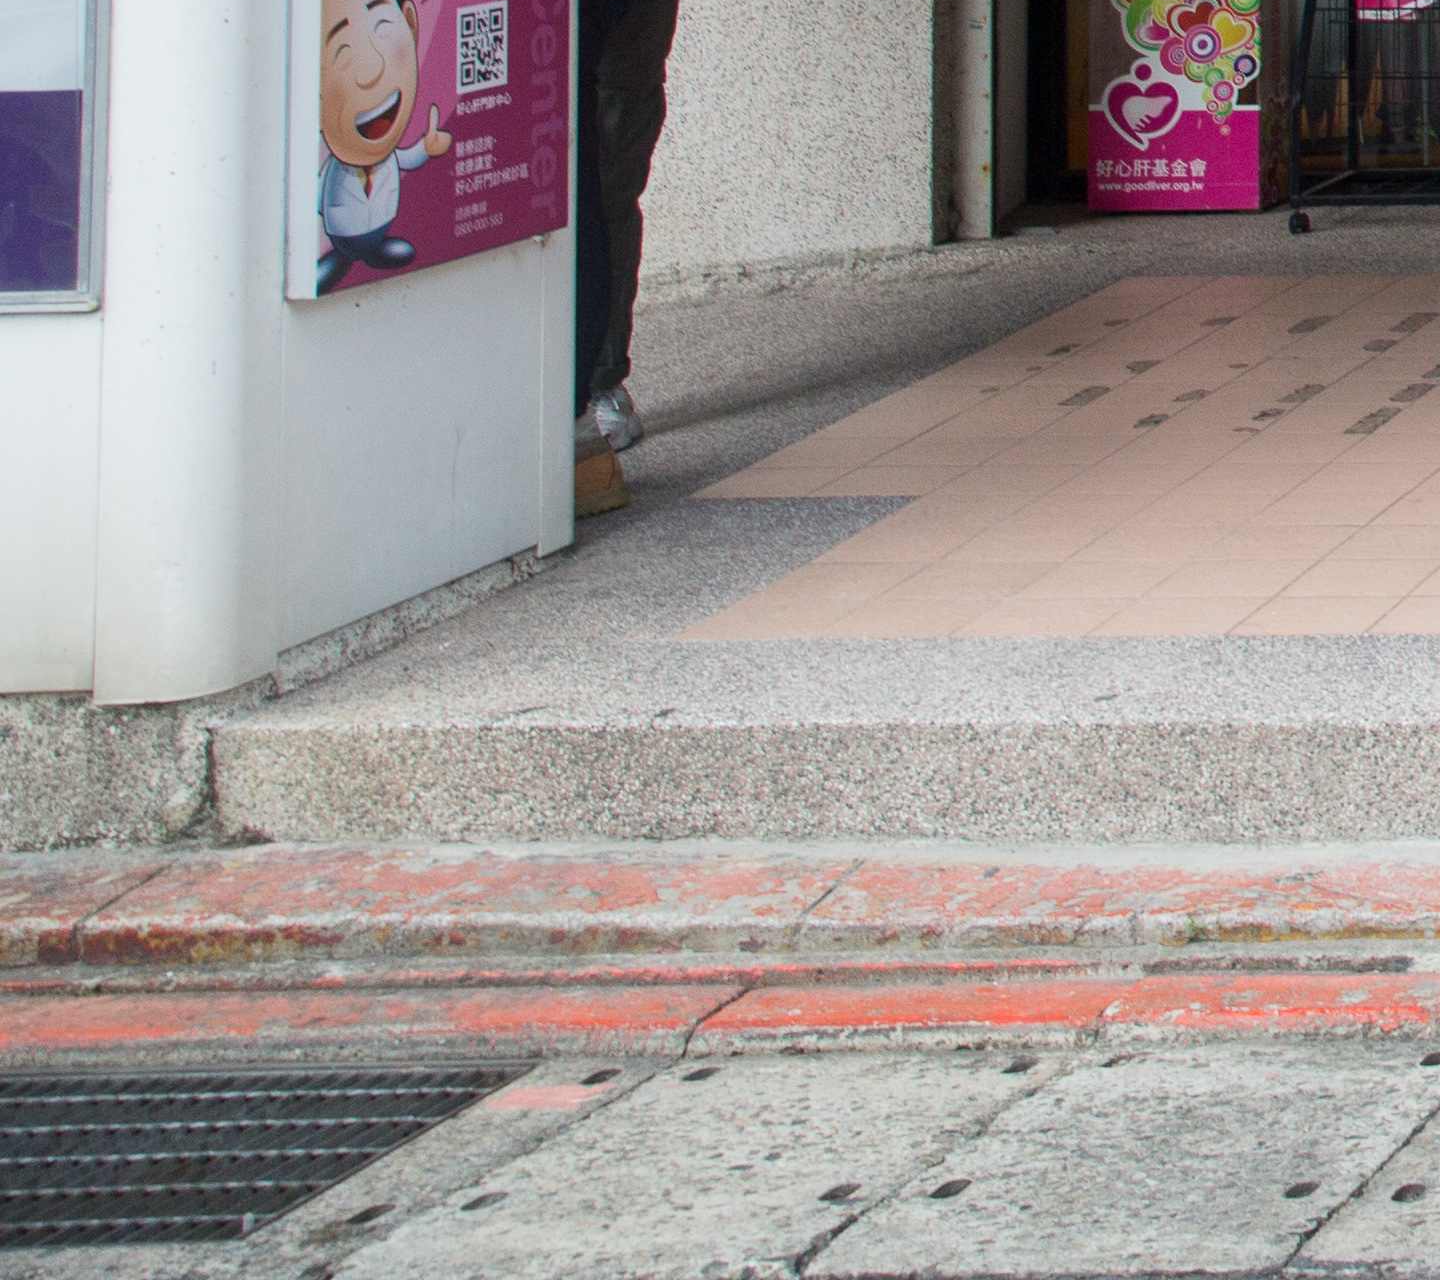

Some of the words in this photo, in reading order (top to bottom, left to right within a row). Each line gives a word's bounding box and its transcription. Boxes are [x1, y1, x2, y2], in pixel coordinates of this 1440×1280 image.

[1095, 158, 1208, 178] 好心肝基金會
